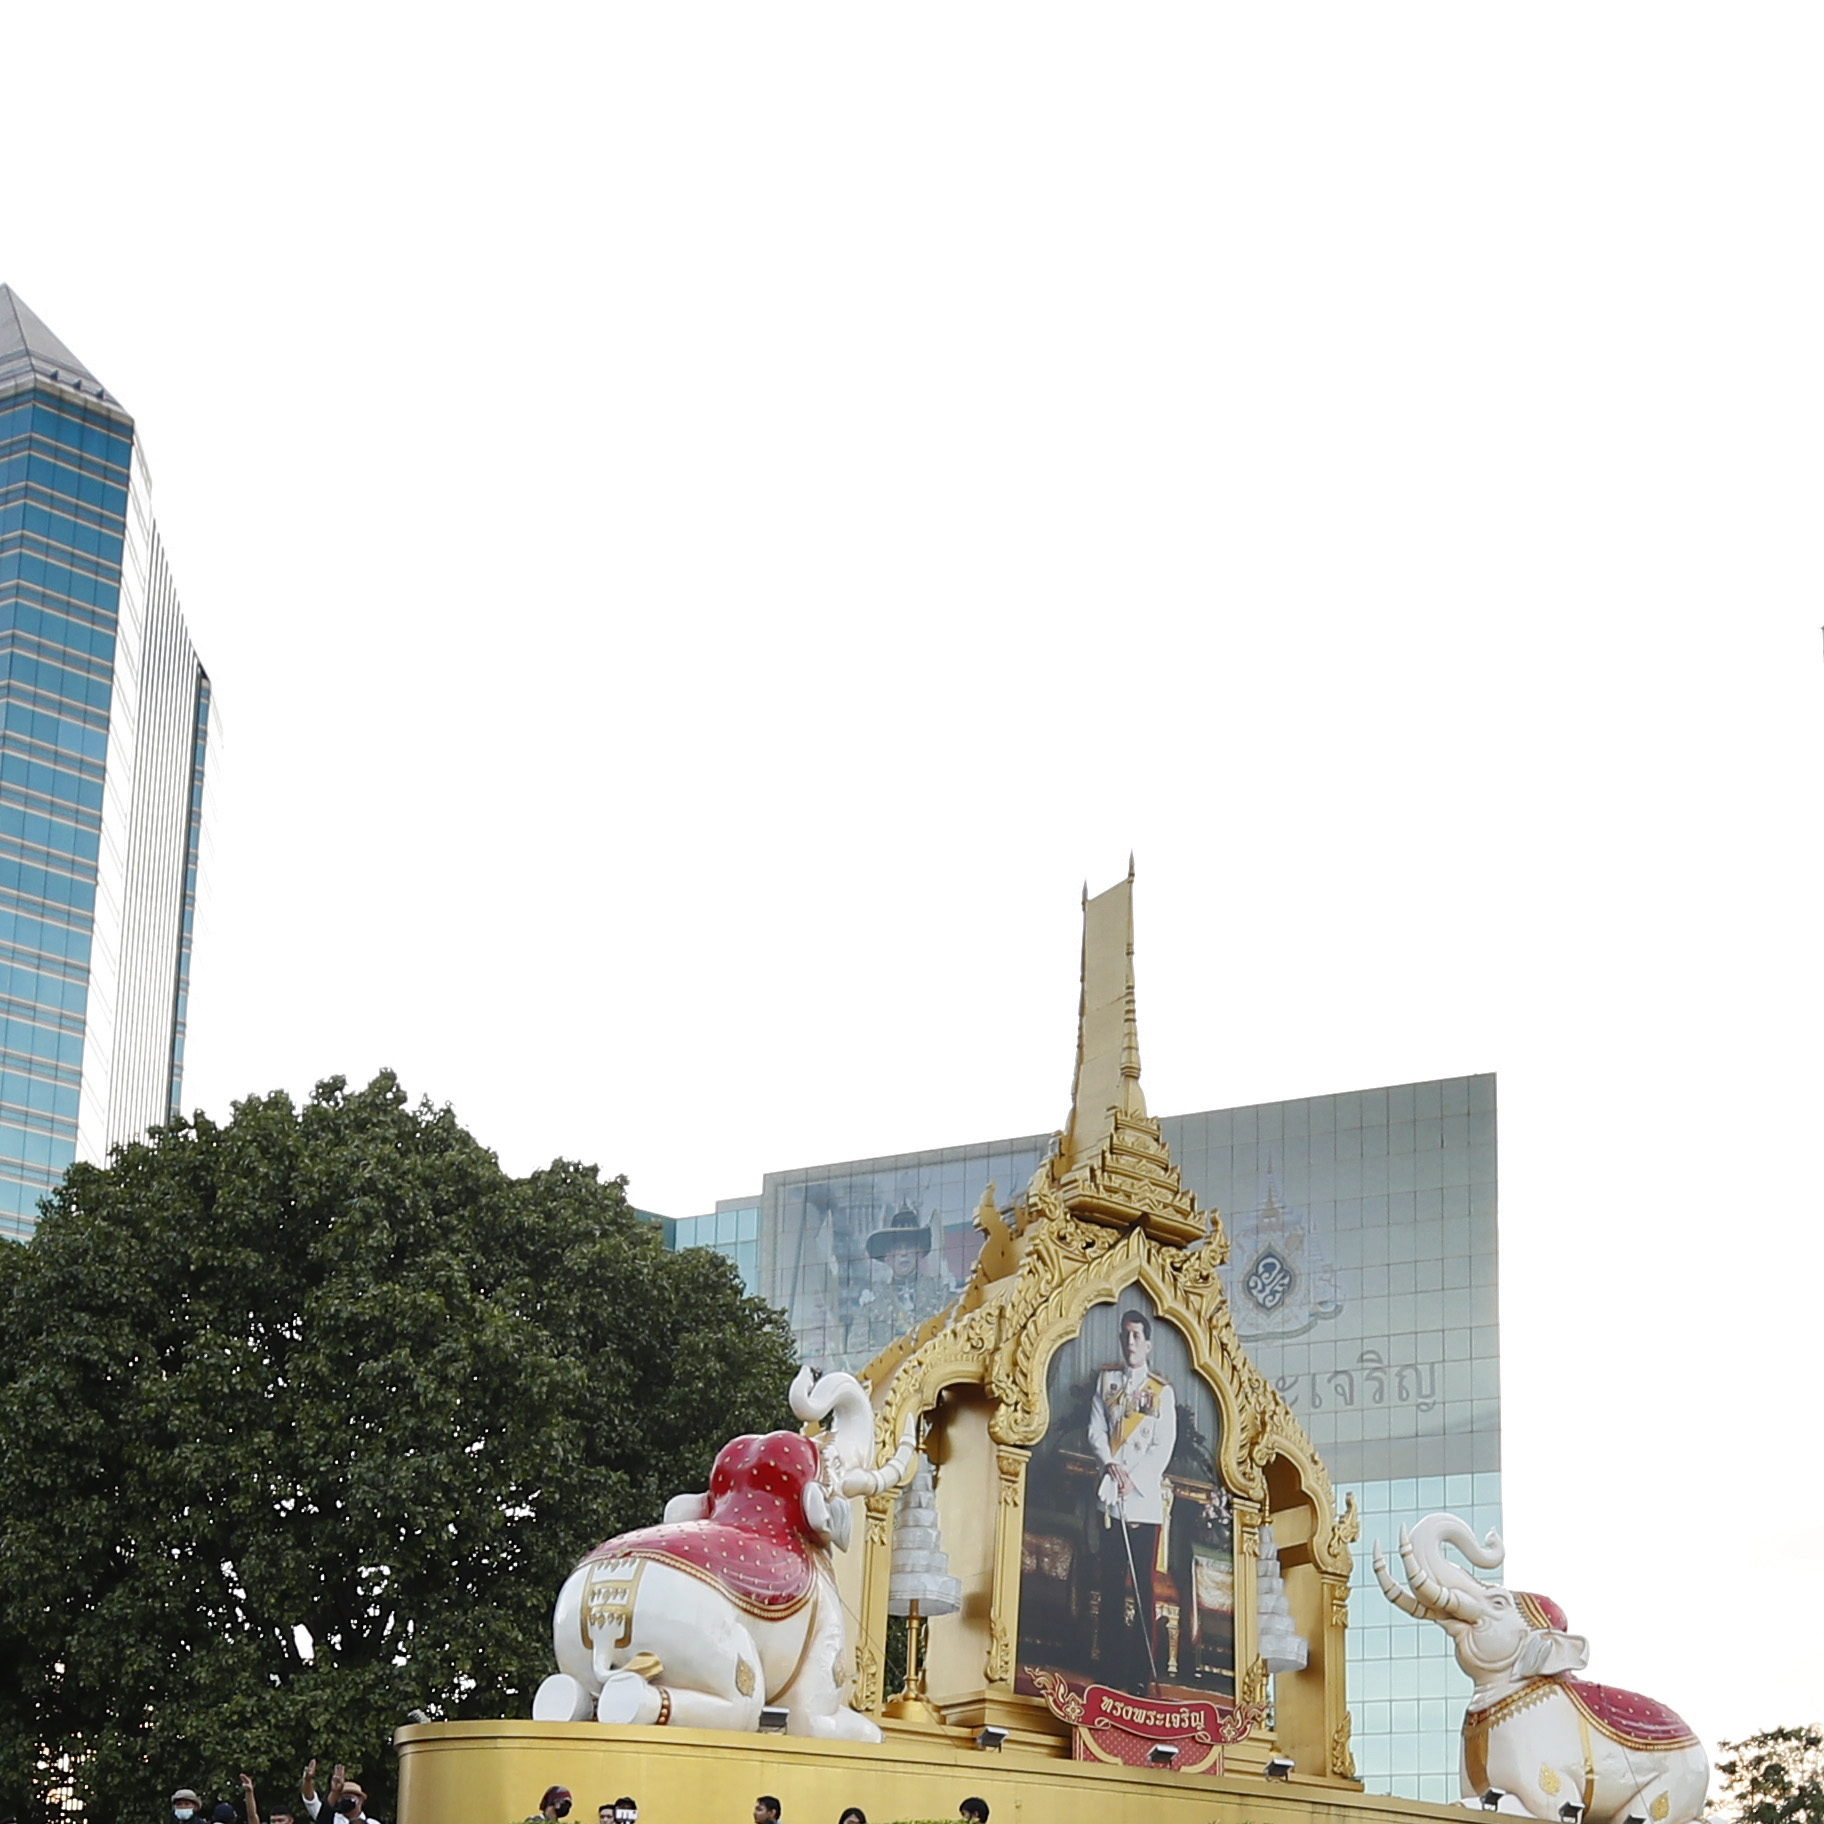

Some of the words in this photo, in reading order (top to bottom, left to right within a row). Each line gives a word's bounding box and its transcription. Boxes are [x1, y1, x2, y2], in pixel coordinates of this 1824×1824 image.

[1275, 1349, 1436, 1413] ะเจริญ
[1100, 1695, 1205, 1731] ทรงพระเจริญ
